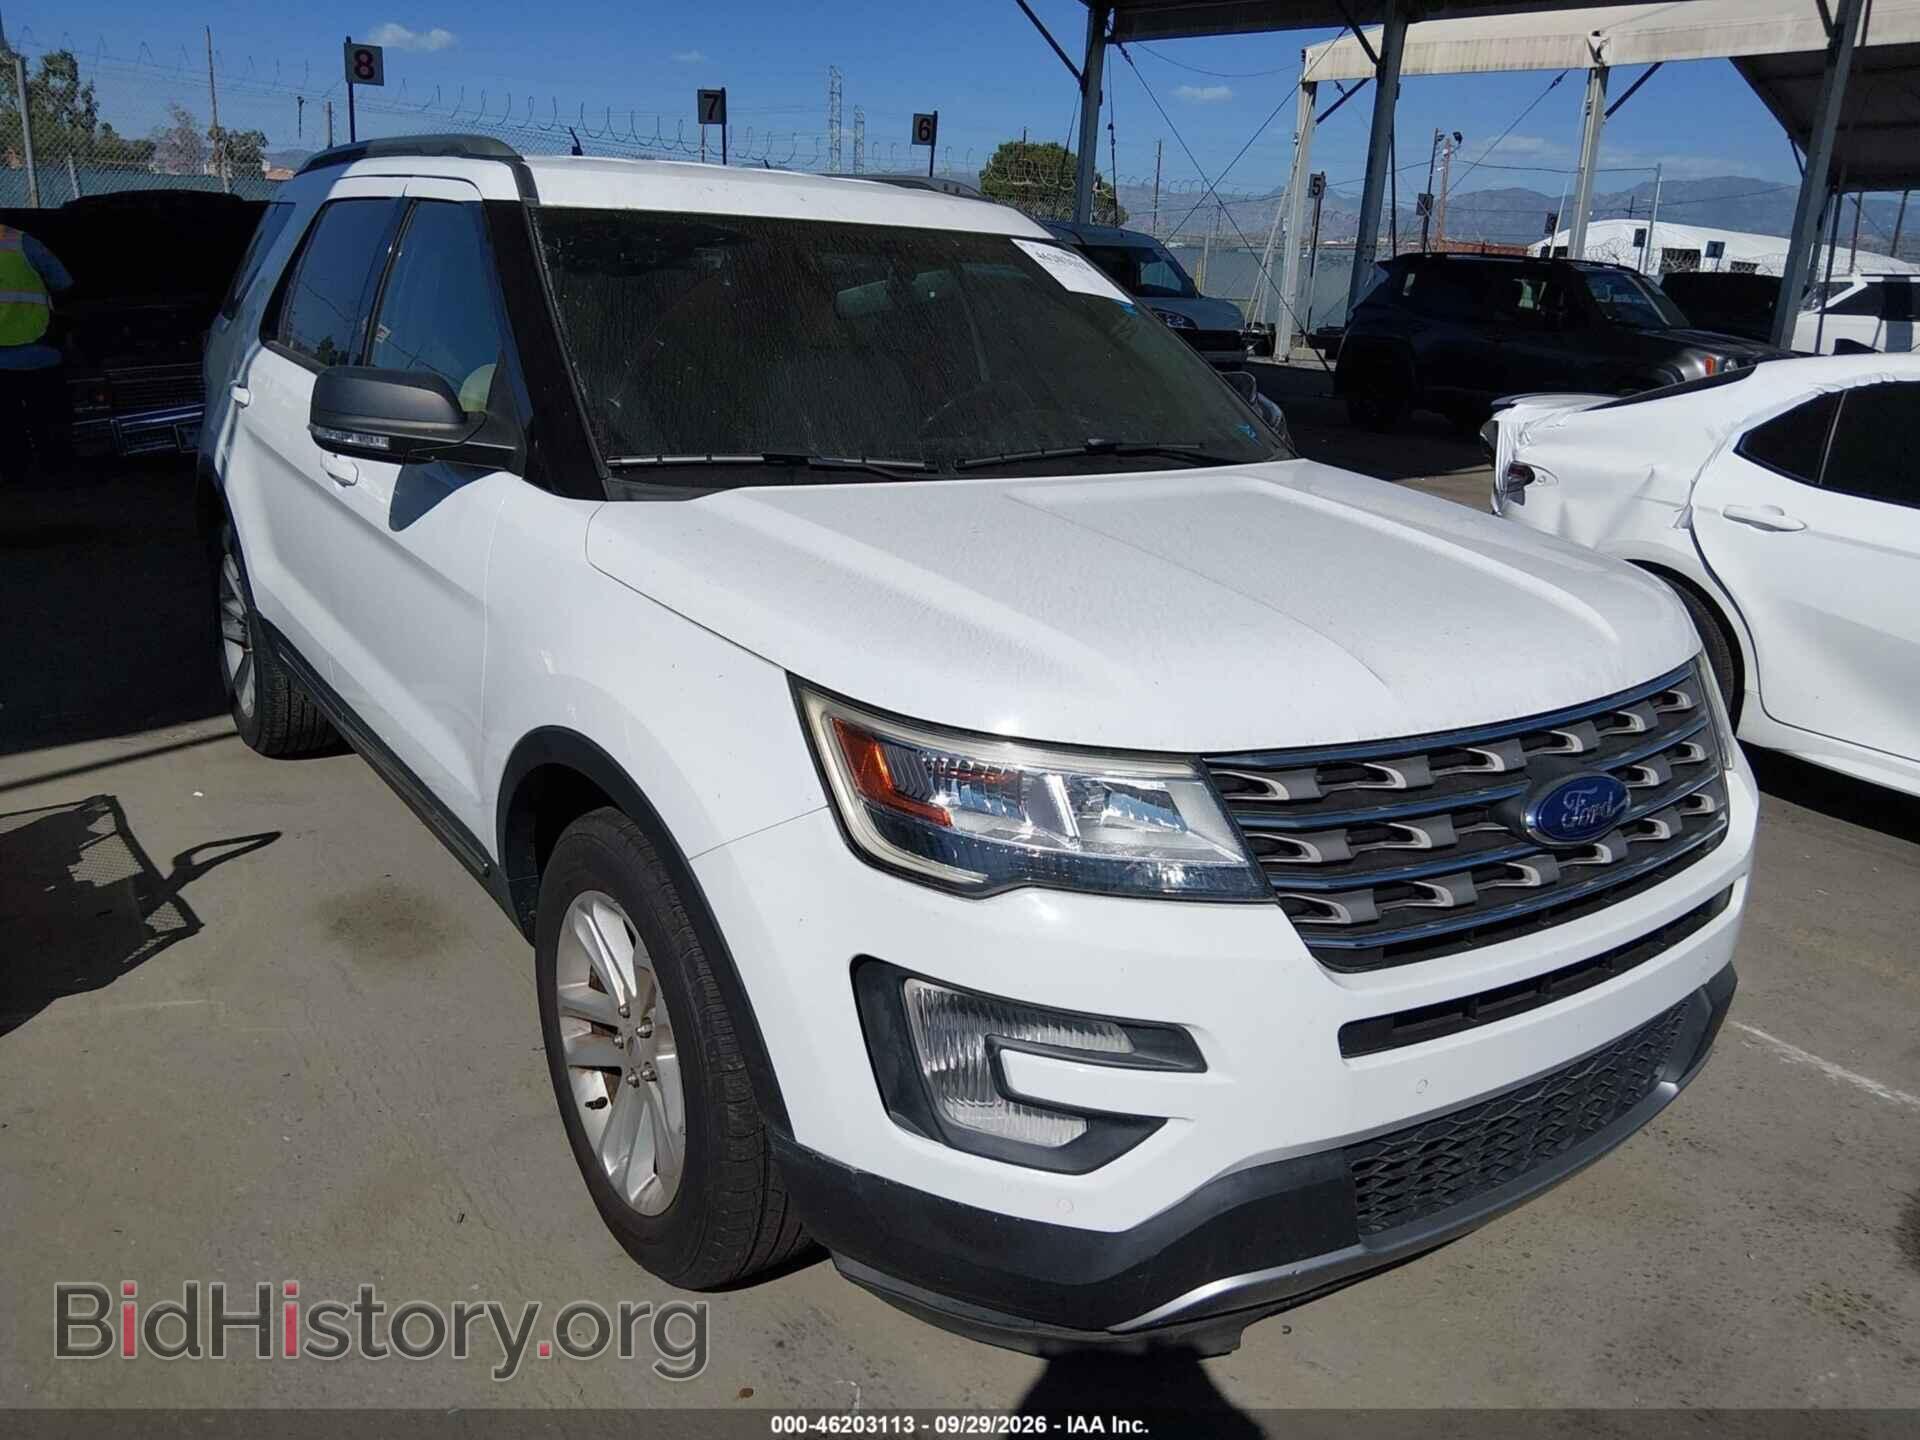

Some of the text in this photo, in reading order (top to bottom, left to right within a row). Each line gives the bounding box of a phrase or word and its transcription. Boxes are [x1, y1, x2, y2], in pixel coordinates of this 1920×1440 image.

[353, 48, 376, 81] 8
[702, 92, 722, 121] 7
[918, 117, 931, 142] 6
[1312, 176, 1322, 196] 5
[1561, 786, 1617, 832] Ford
